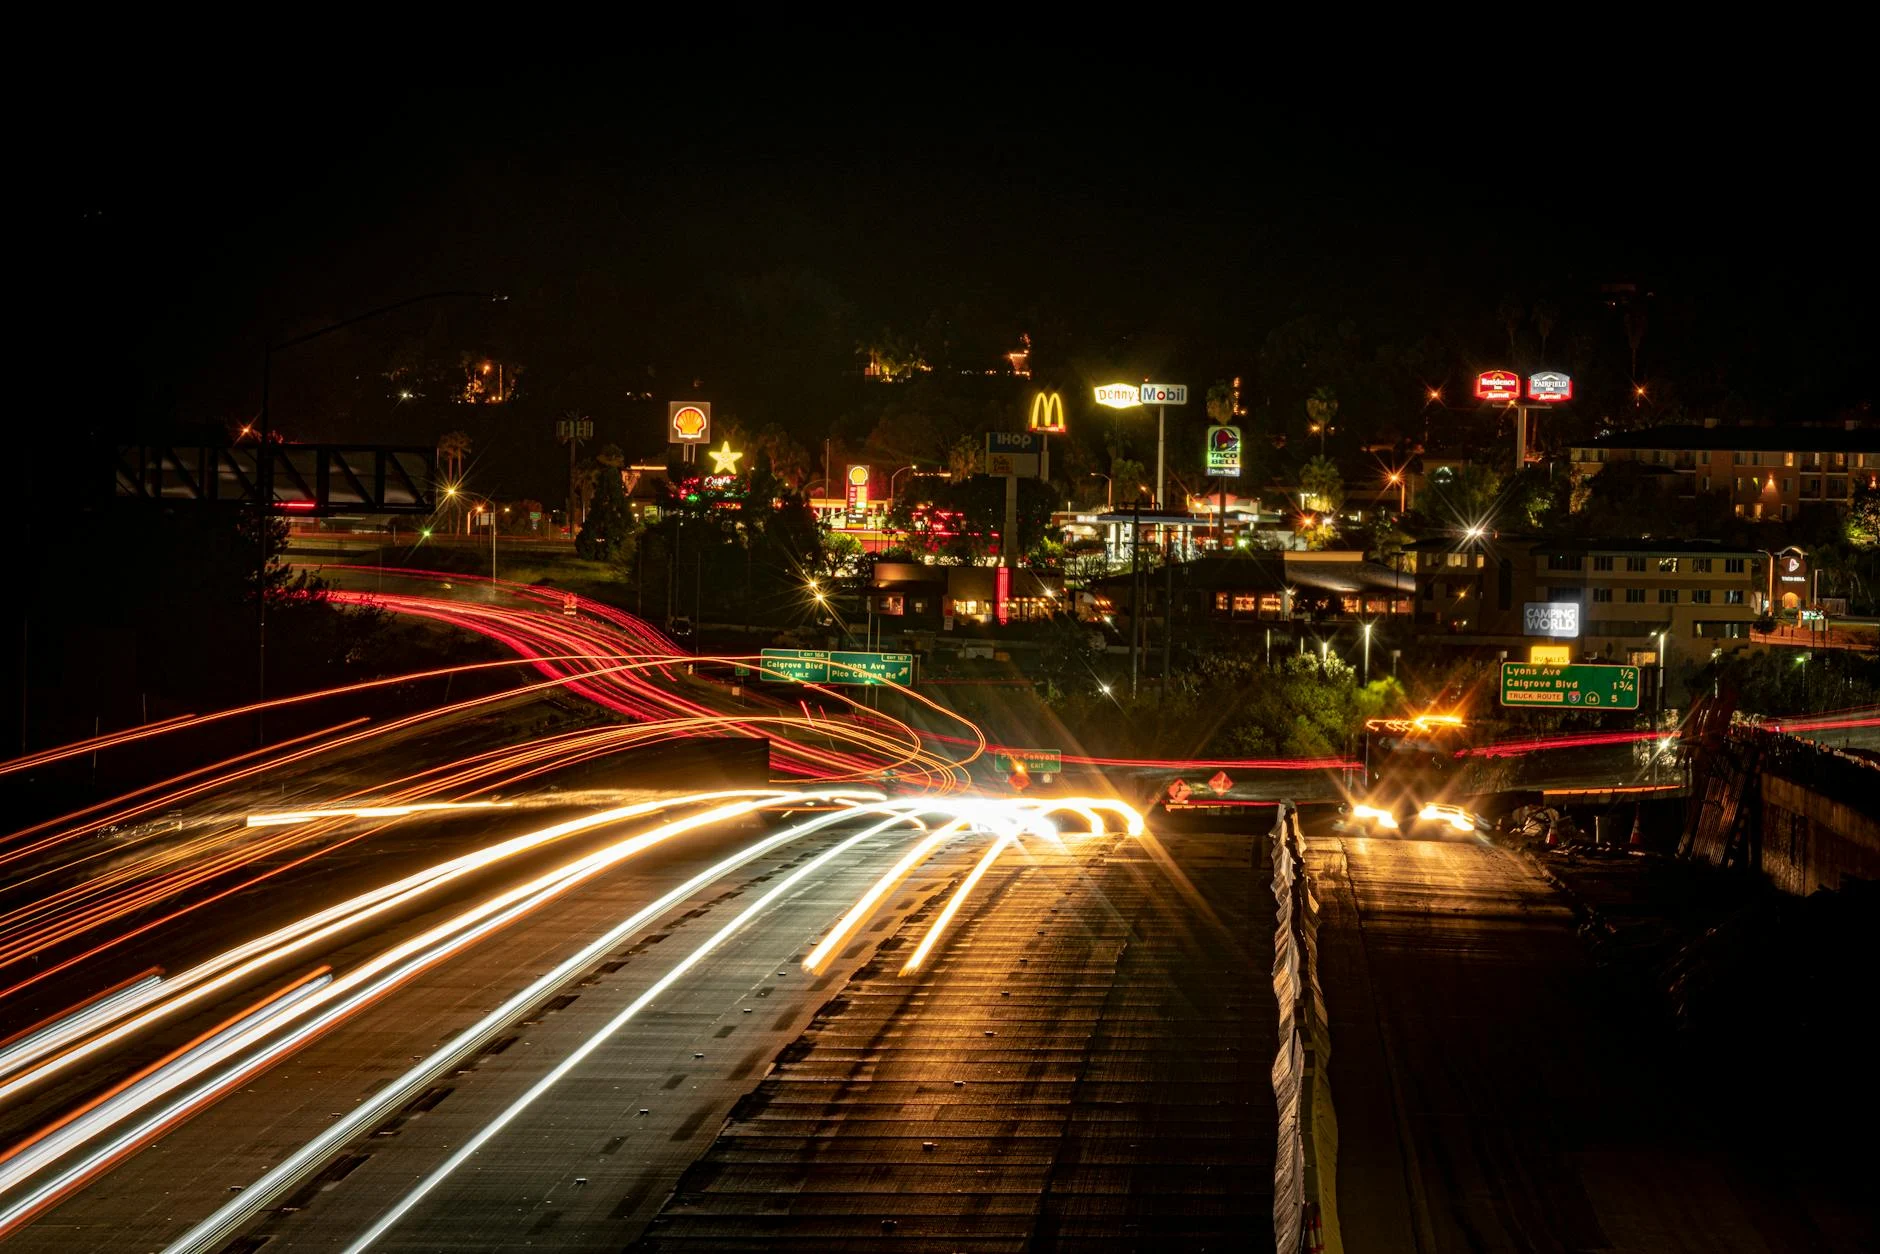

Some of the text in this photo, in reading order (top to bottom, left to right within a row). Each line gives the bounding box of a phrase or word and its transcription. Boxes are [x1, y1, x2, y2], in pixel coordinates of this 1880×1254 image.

[1099, 389, 1140, 402] Denny'
[1143, 387, 1185, 401] Mobil
[1526, 608, 1576, 619] CAMPING
[1527, 618, 1576, 630] WORLD
[804, 662, 824, 670] Blvd
[870, 662, 886, 670] Ave
[1507, 666, 1561, 676] Lyons Ave
[832, 670, 850, 678] Pico
[1620, 668, 1634, 680] 1/2
[1507, 678, 1578, 689] Calgrove Blvd
[1611, 694, 1618, 702] 5
[1023, 753, 1056, 761] Canyon
